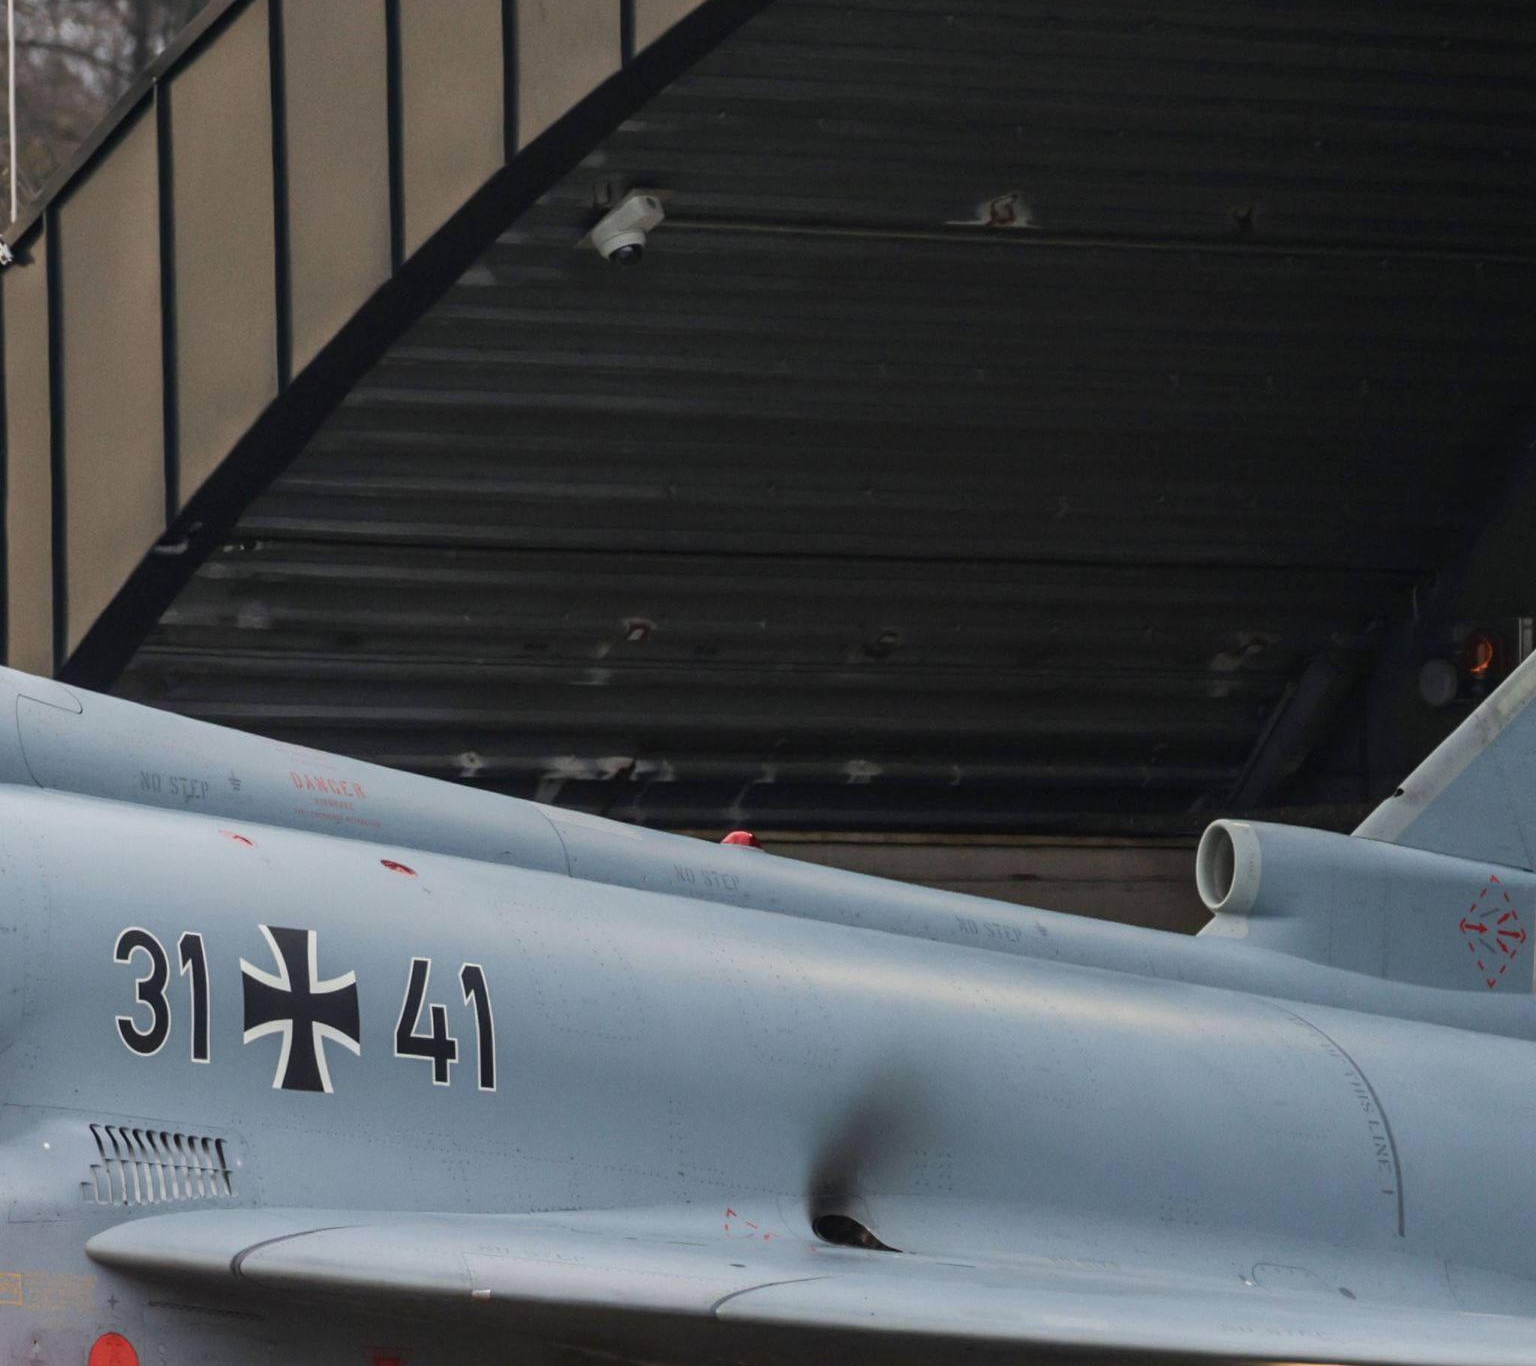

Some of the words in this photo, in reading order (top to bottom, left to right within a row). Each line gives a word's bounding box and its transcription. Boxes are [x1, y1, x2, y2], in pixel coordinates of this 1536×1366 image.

[140, 770, 161, 792] NO
[169, 776, 209, 799] STEP
[290, 770, 367, 799] DANGER
[673, 865, 696, 885] NO
[701, 869, 740, 891] STEP
[983, 921, 1022, 943] STEP
[112, 925, 211, 1064] 31
[392, 957, 497, 1092] 41
[1367, 1119, 1393, 1173] LINE
